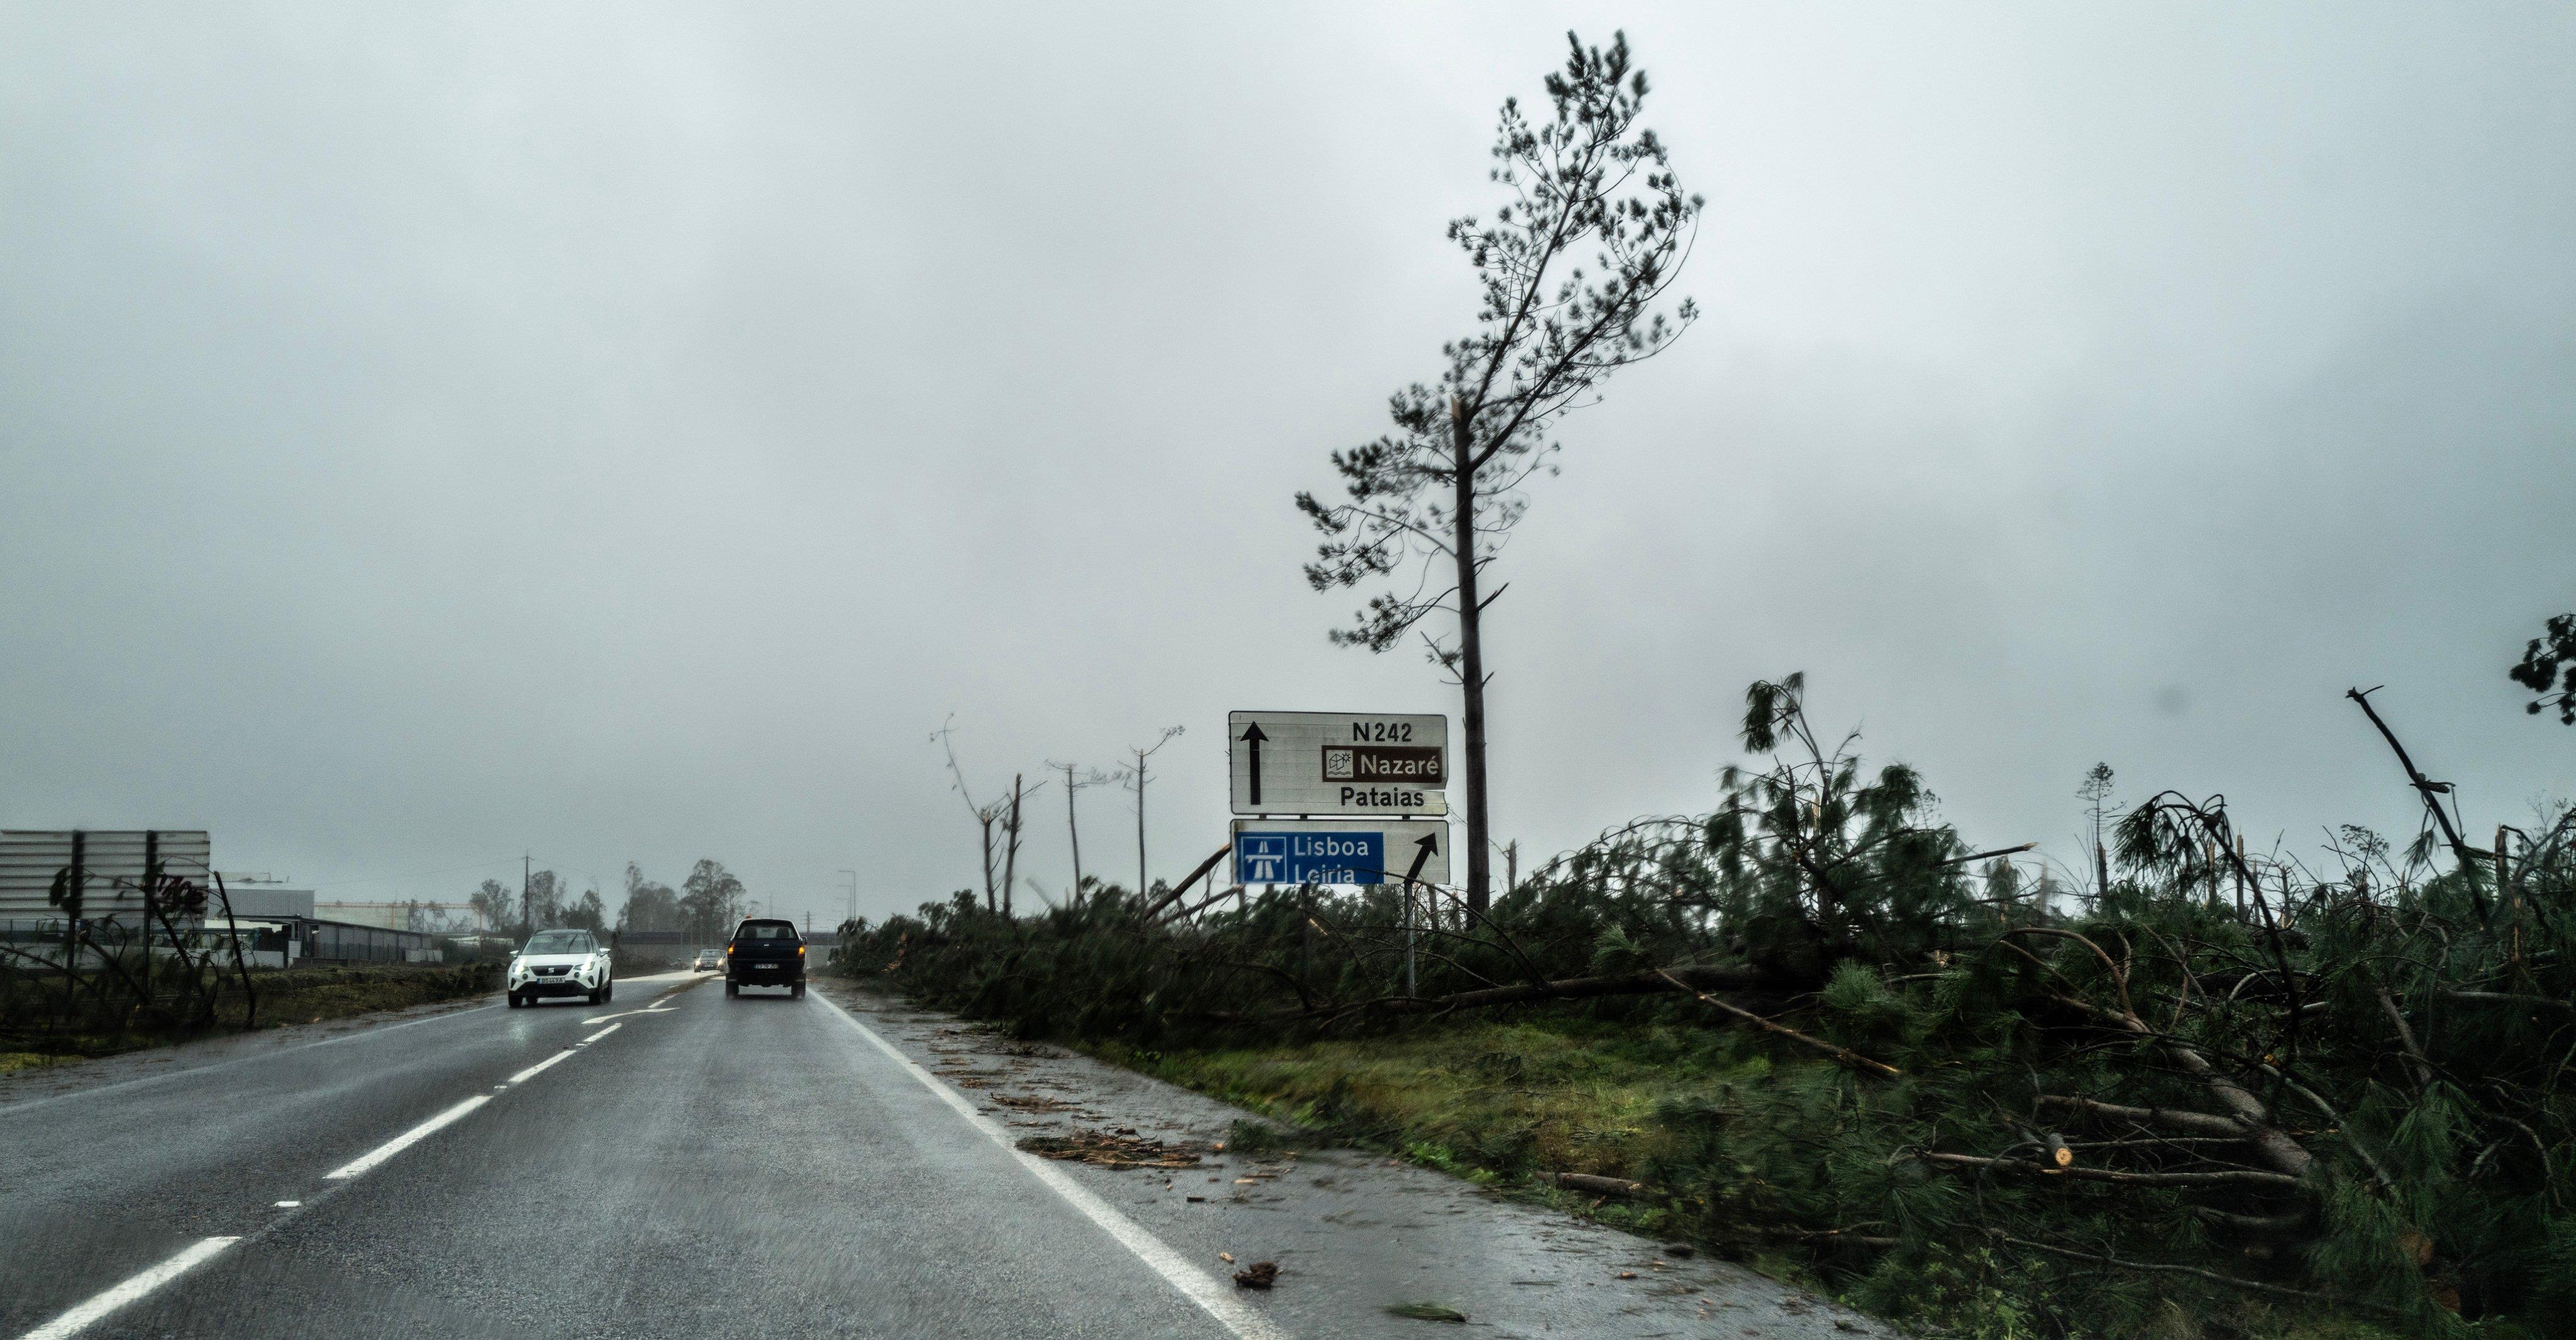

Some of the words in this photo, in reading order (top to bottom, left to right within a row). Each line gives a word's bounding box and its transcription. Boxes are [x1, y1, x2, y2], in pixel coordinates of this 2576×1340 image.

[1360, 755, 1439, 775] Nazaré
[1341, 786, 1424, 807] Pataias
[1294, 836, 1368, 856] Lisboa
[1294, 864, 1355, 883] Leiria
